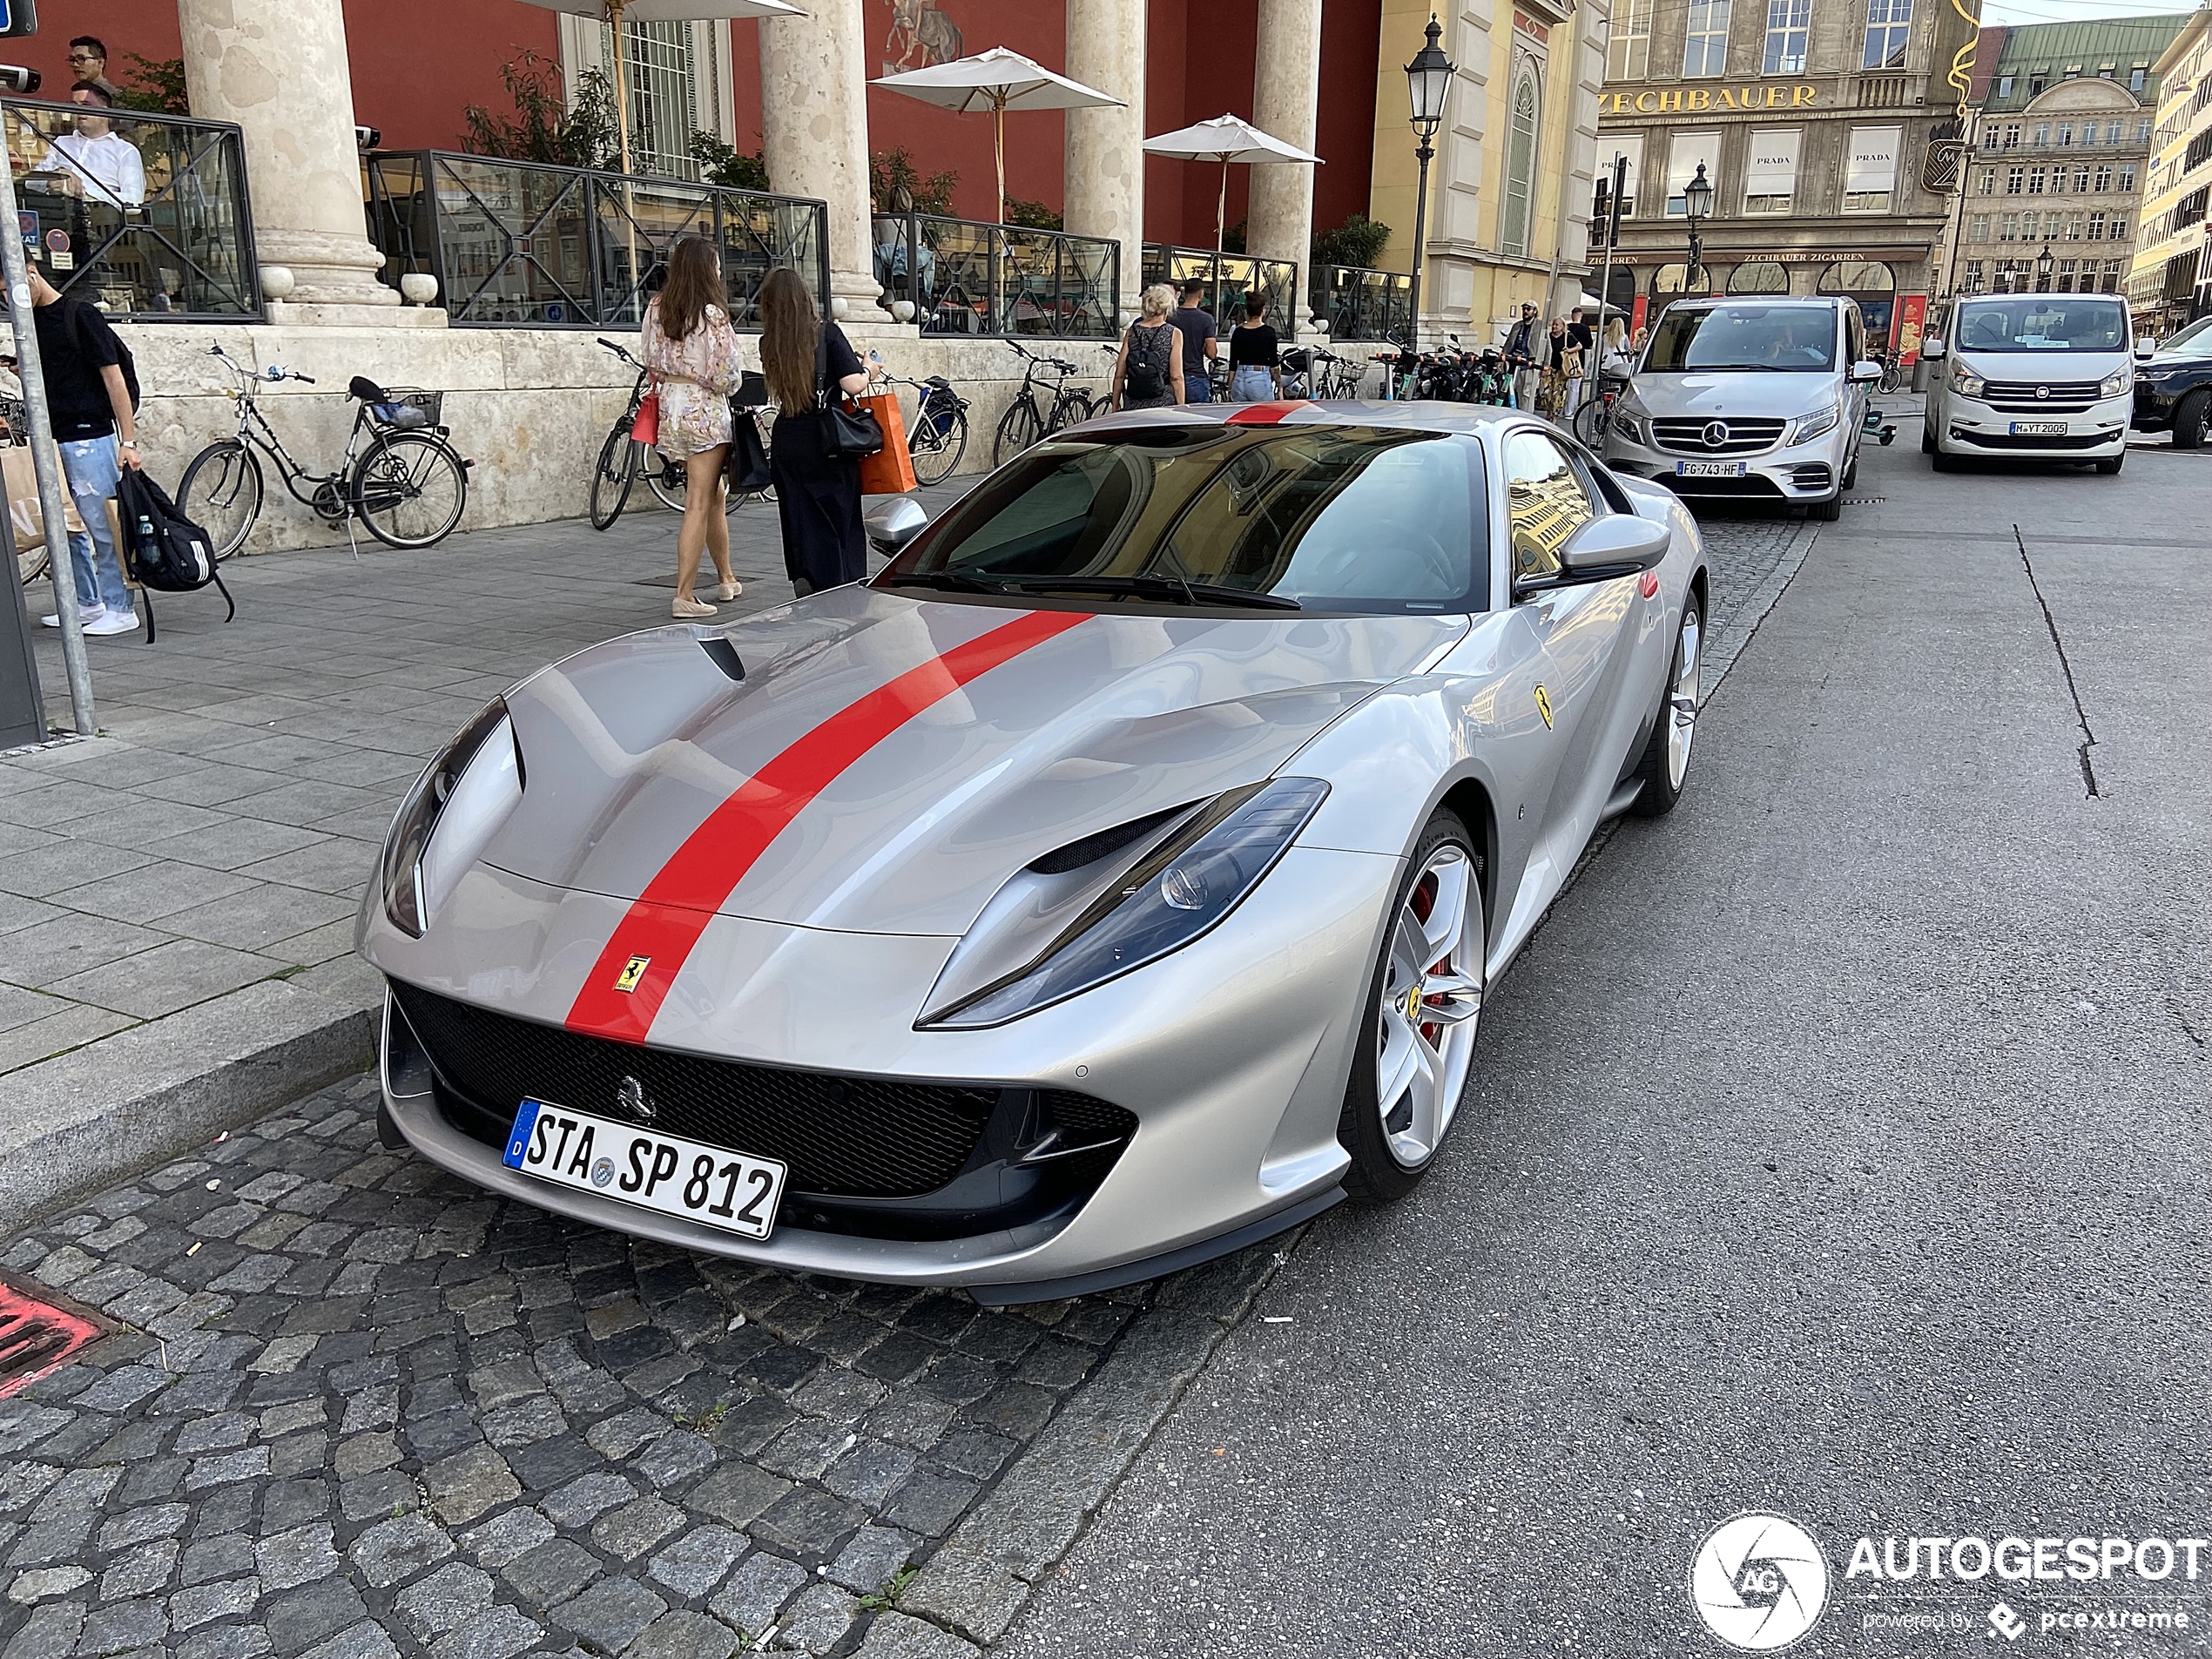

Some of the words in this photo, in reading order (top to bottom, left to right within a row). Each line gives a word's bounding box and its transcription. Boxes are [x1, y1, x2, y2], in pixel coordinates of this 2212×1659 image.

[1597, 85, 1817, 114] ZECHBAUER
[1757, 157, 1791, 165] PRADA
[1856, 153, 1891, 162] PRADA
[1588, 256, 1639, 265] ZIGRREN
[1743, 253, 1807, 262] ZECHBAUER
[1810, 253, 1865, 261] ZIGARREN
[2028, 424, 2040, 433] YT
[2041, 424, 2065, 433] 2005
[1683, 463, 1737, 475] FG-743-HF
[512, 1141, 523, 1157] D
[527, 1114, 596, 1179] STA
[618, 1138, 679, 1197] SP
[683, 1154, 774, 1226] 812
